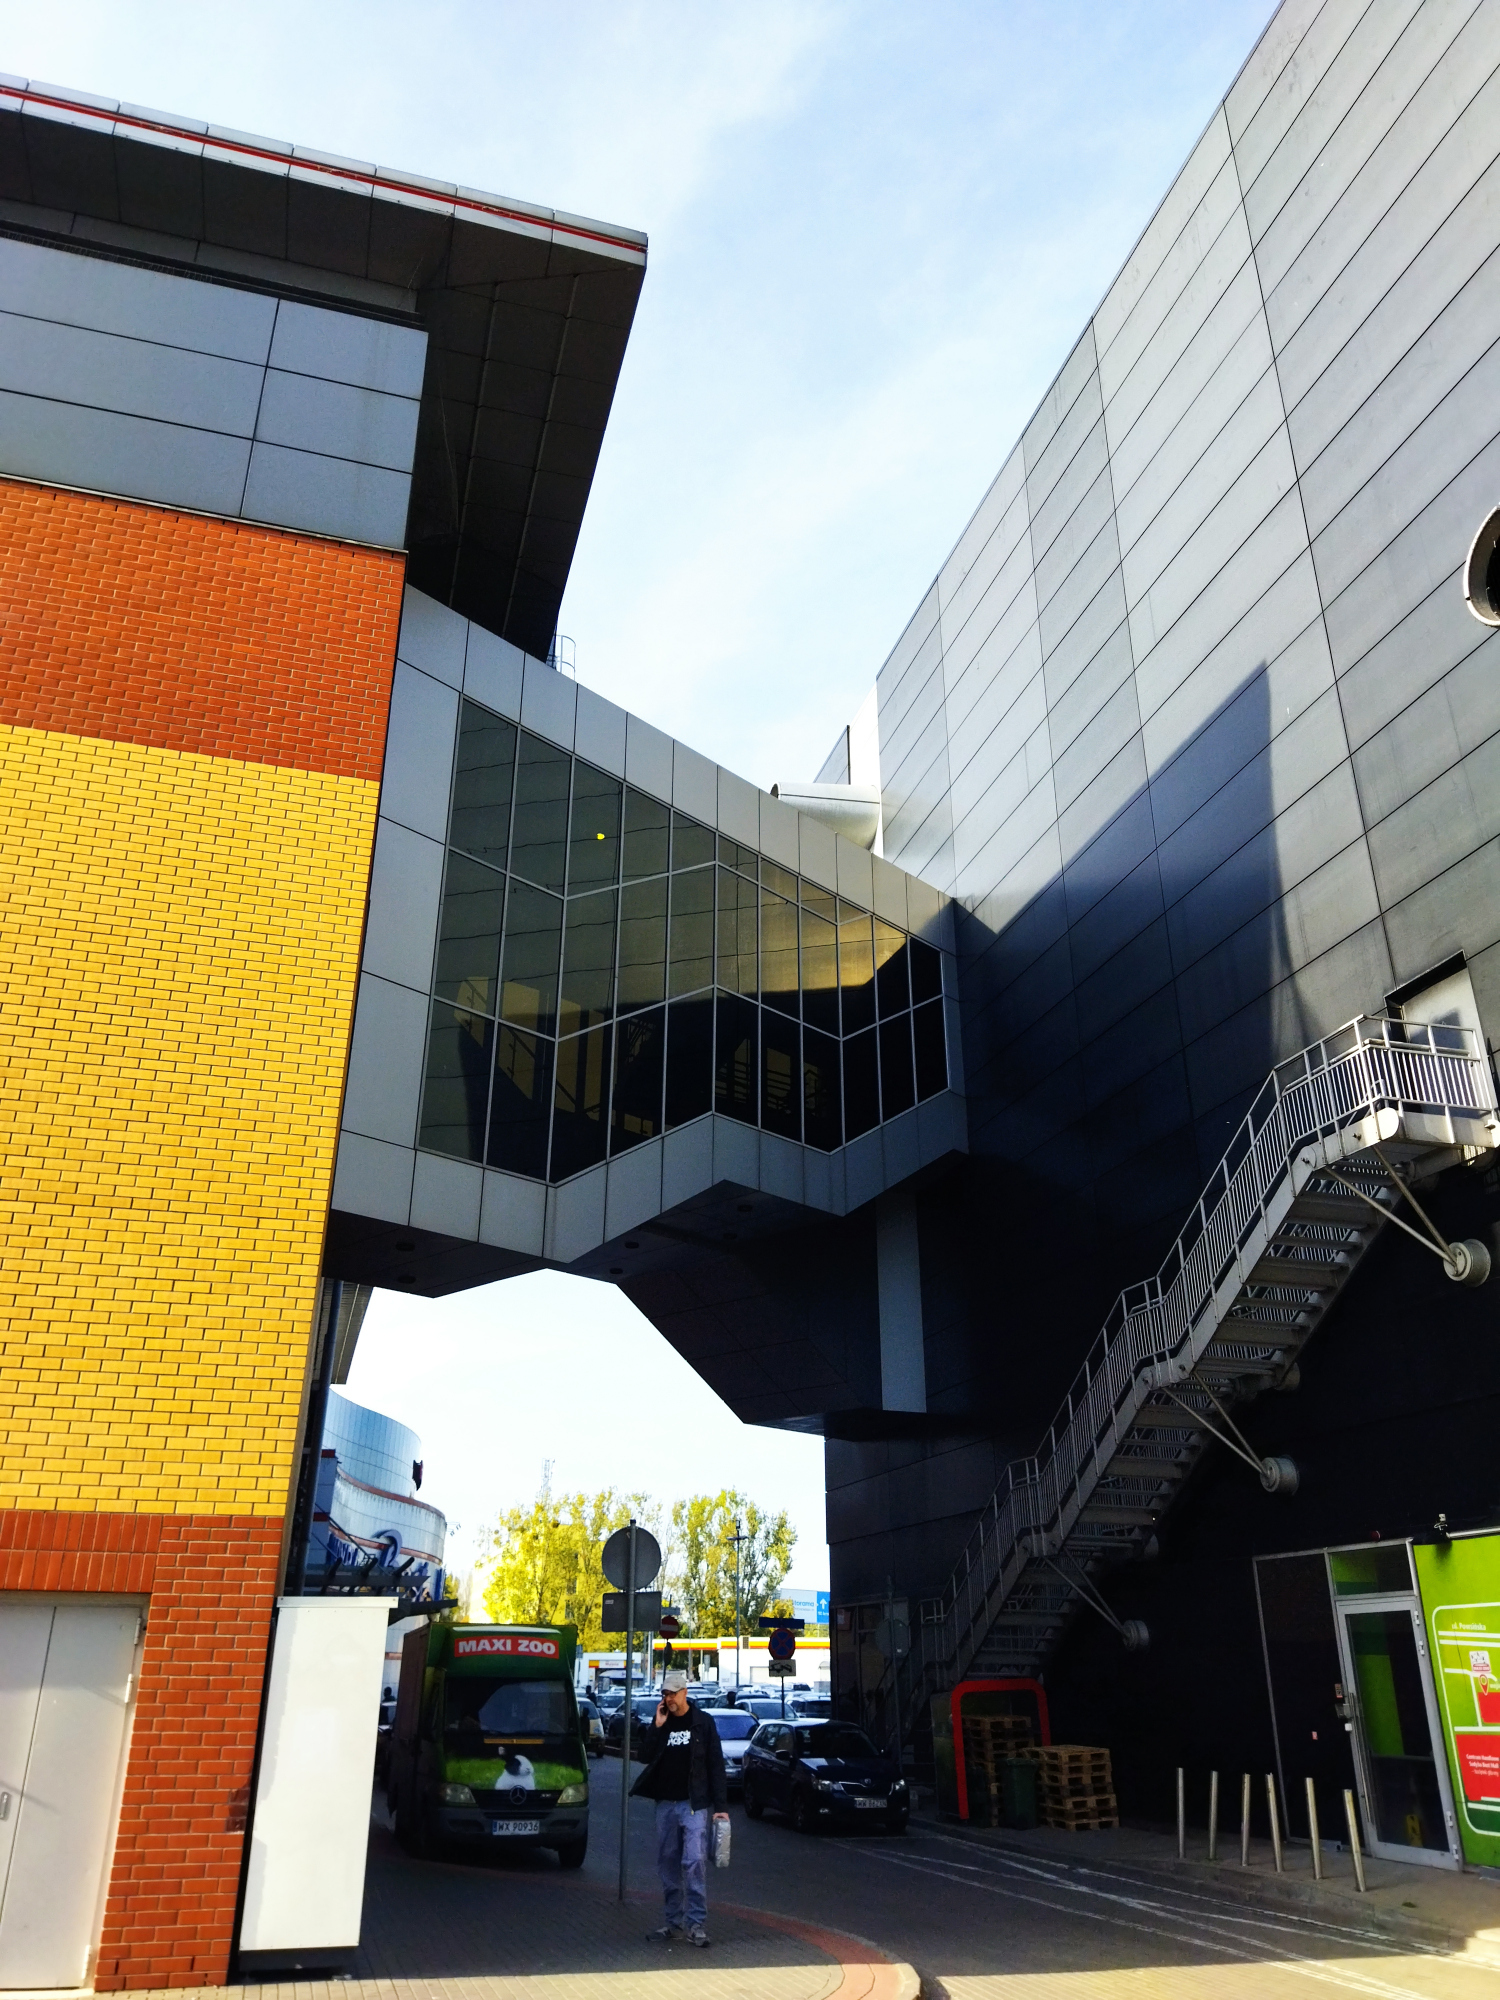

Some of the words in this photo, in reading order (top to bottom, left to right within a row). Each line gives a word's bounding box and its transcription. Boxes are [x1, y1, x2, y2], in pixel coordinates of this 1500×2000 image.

[458, 1639, 512, 1653] MAXI
[518, 1640, 556, 1655] ZOO
[498, 1821, 511, 1831] WX
[512, 1821, 539, 1832] 90936
